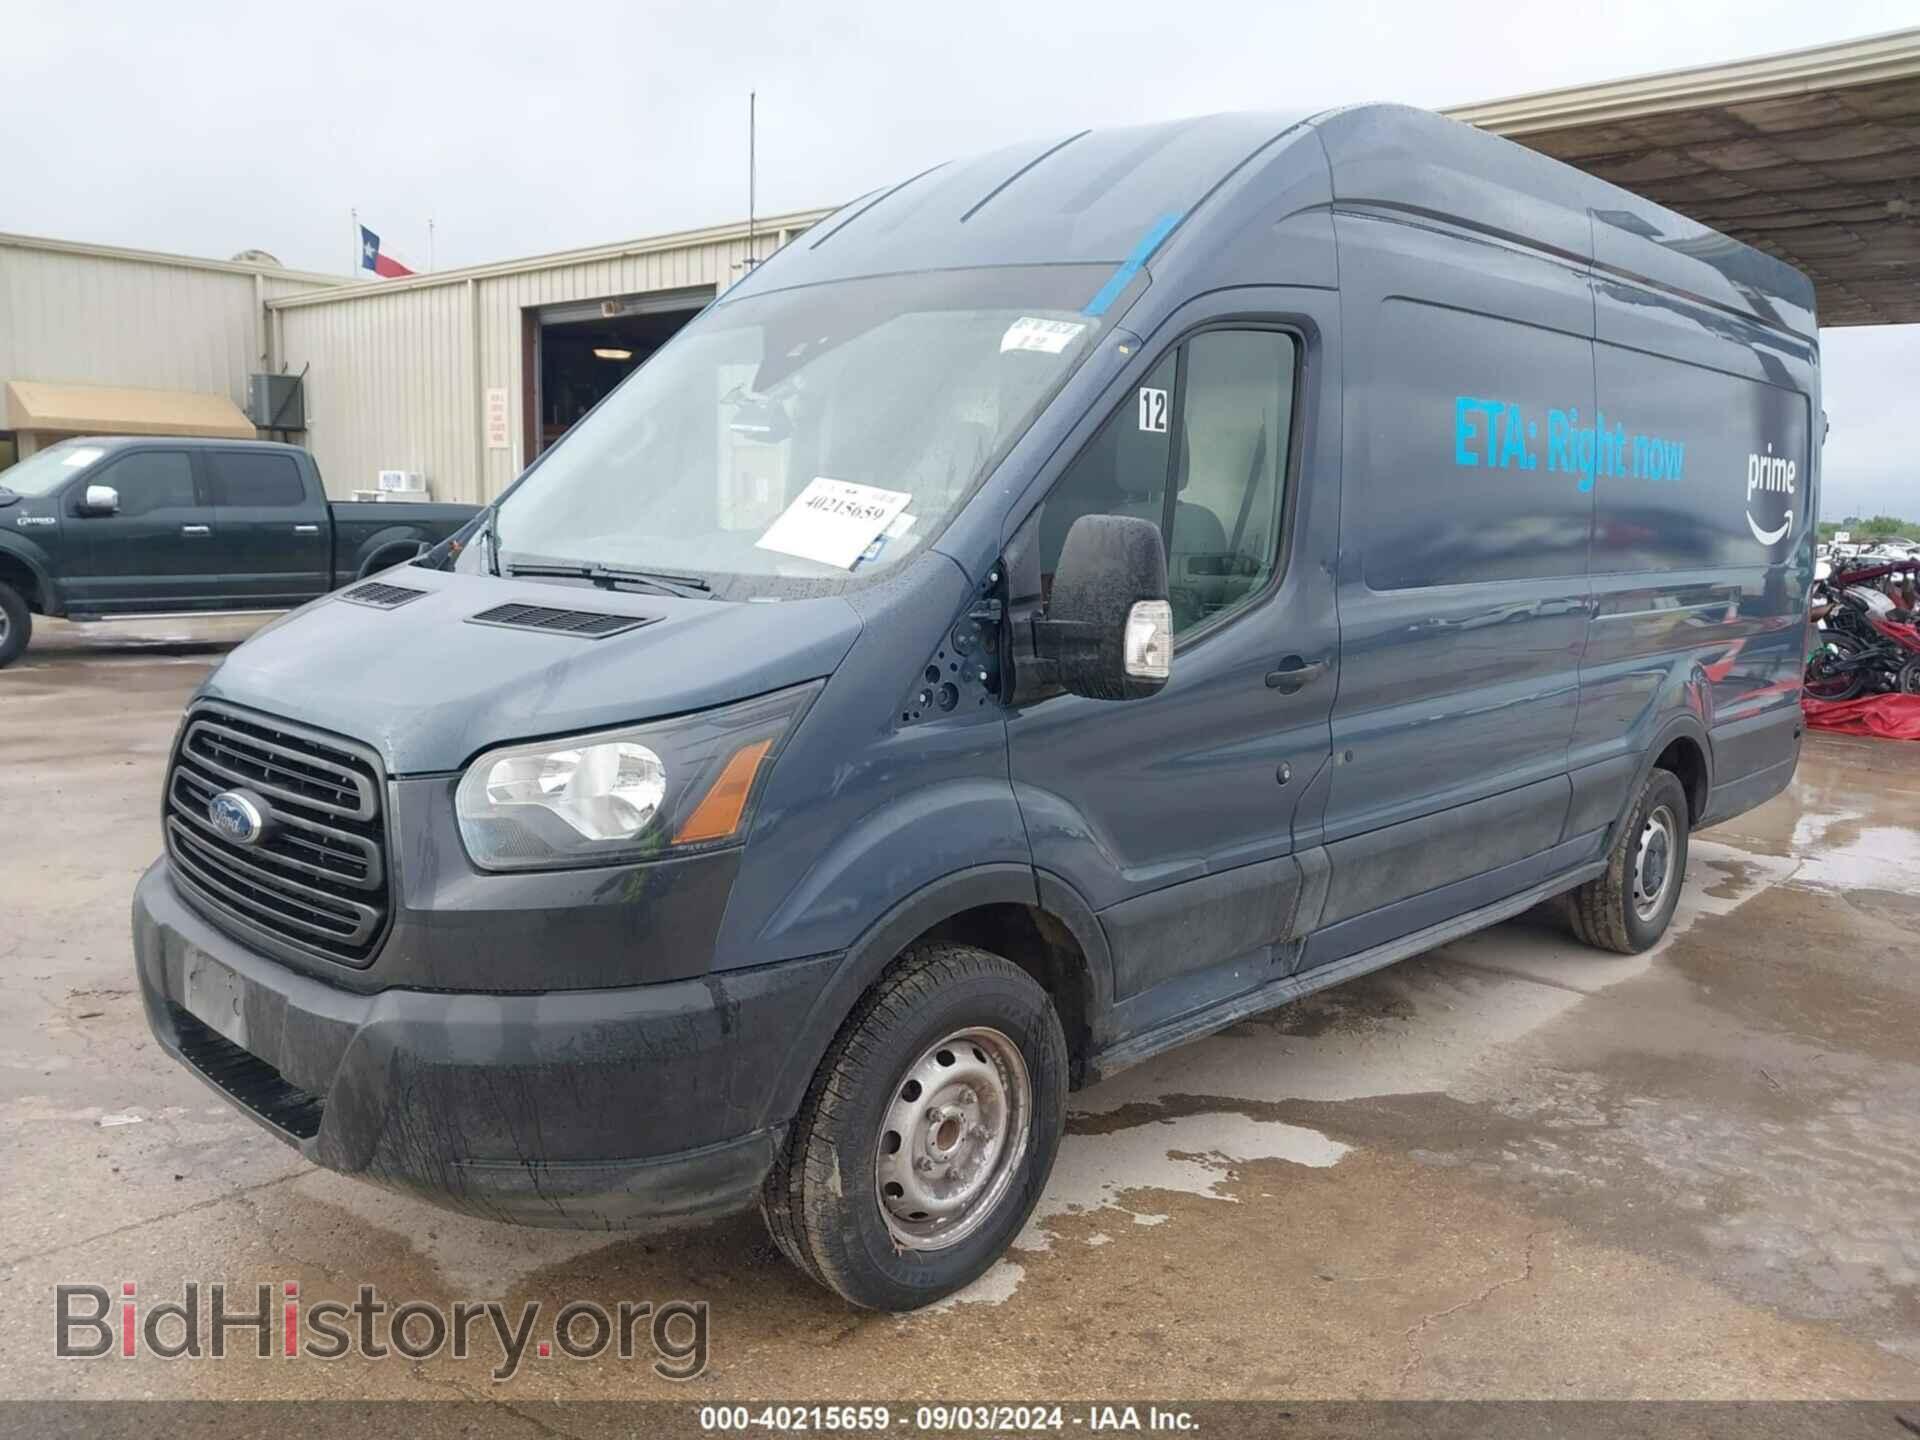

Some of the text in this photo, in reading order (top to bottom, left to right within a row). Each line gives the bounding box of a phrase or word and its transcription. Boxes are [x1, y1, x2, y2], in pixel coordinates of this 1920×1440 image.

[1142, 390, 1166, 430] 12
[1455, 396, 1685, 492] ETA: Right now
[1746, 442, 1796, 502] prime
